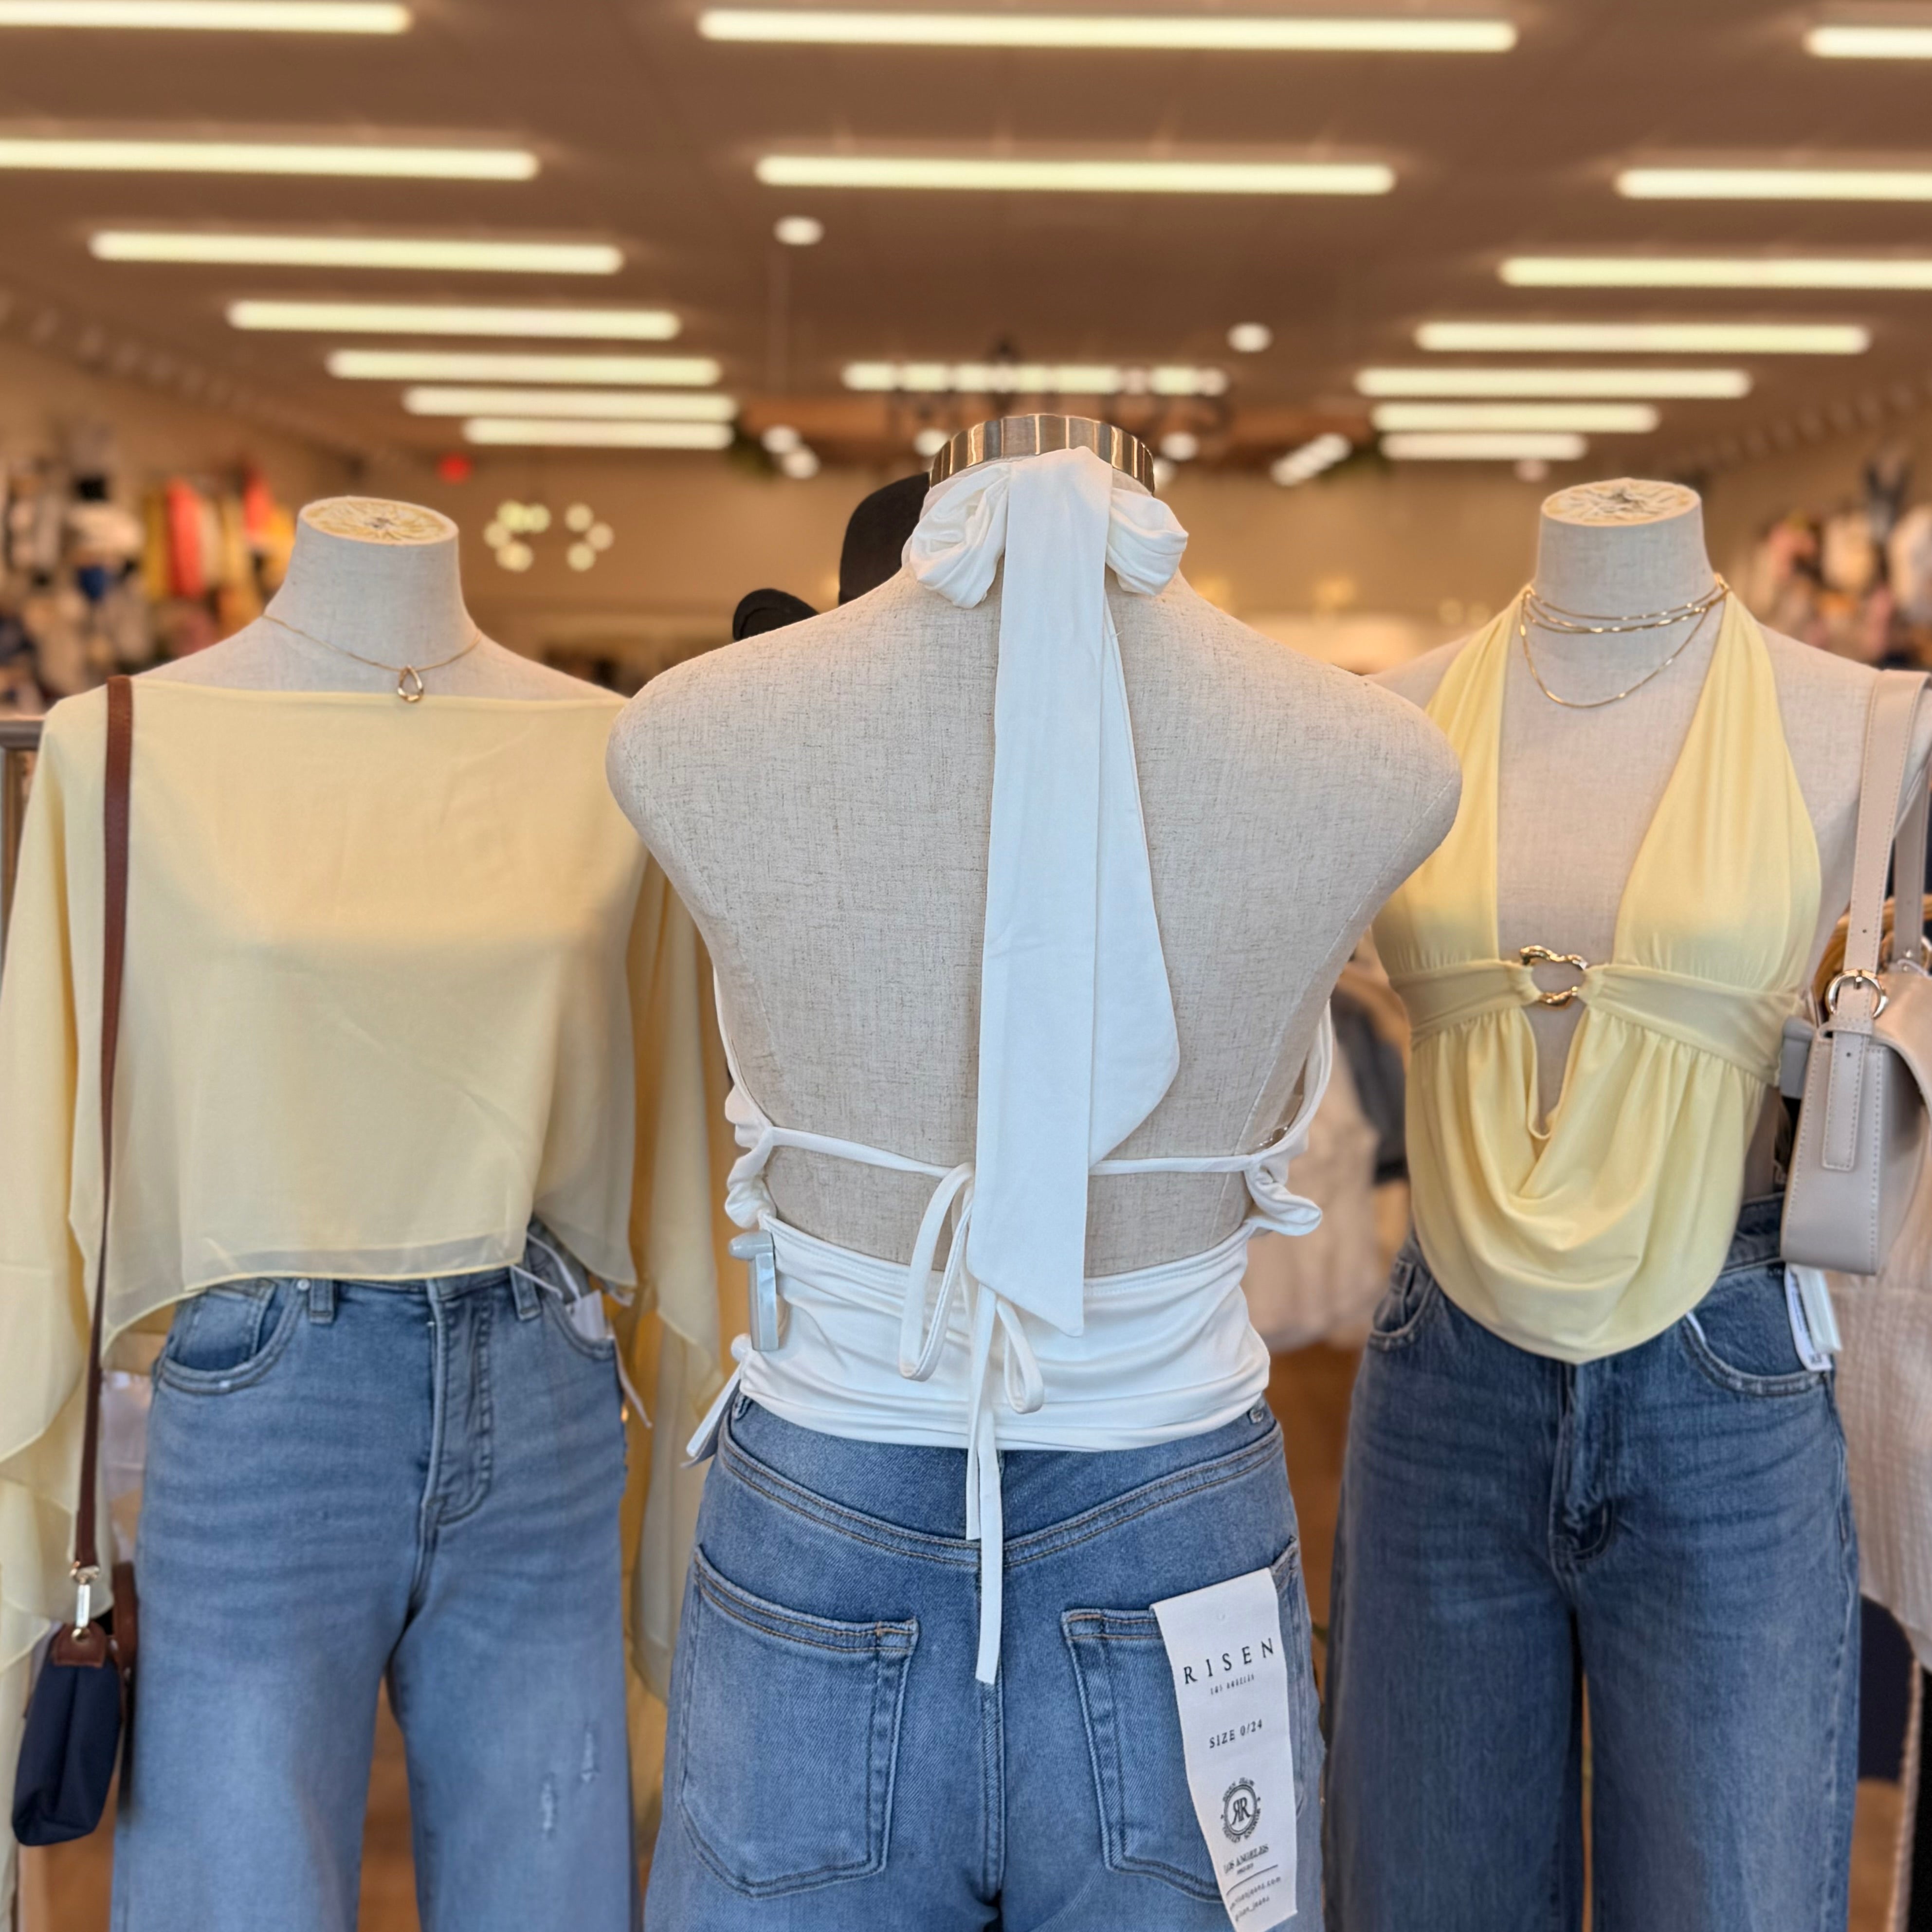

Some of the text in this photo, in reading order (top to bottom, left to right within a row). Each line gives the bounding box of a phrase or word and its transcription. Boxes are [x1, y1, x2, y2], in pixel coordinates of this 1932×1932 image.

[1184, 1638, 1274, 1684] RISEN
[1209, 1718, 1262, 1749] SIZE 0/24
